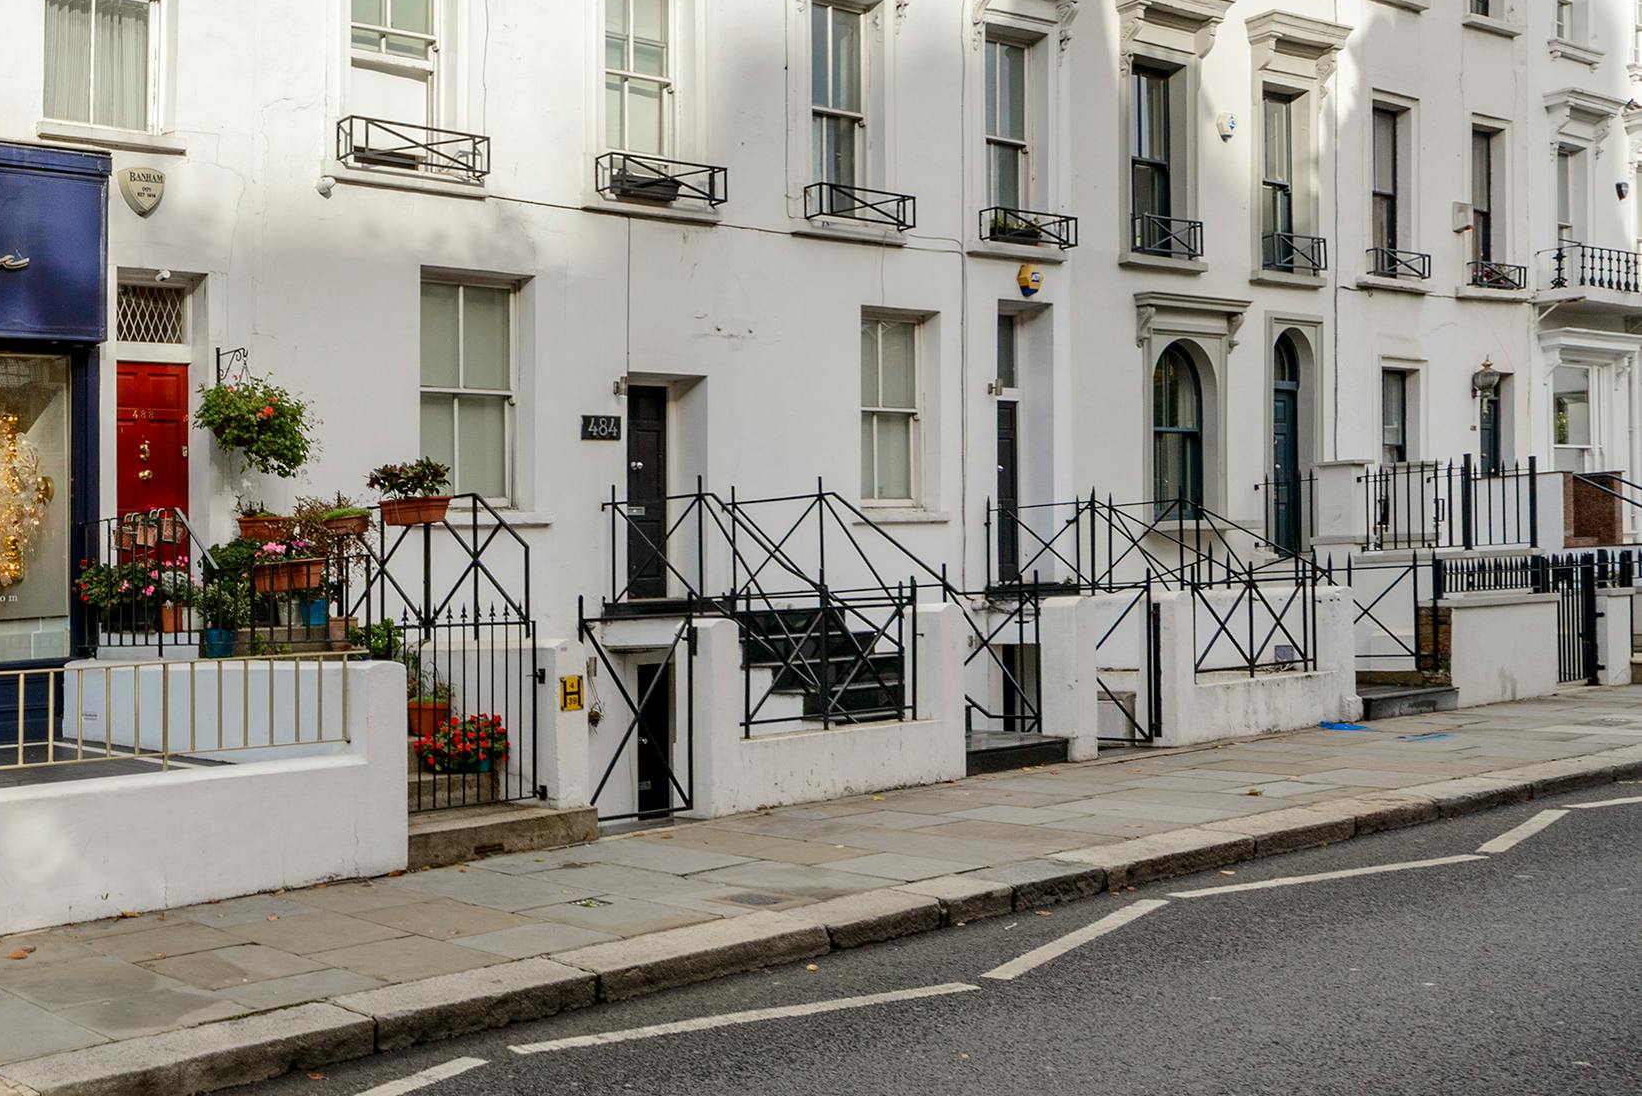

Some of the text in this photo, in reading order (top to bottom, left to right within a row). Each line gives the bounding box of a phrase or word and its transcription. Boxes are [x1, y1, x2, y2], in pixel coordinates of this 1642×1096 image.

[129, 171, 164, 184] BANHAM
[588, 417, 618, 437] 484
[569, 681, 575, 689] 4
[568, 696, 577, 705] 39
